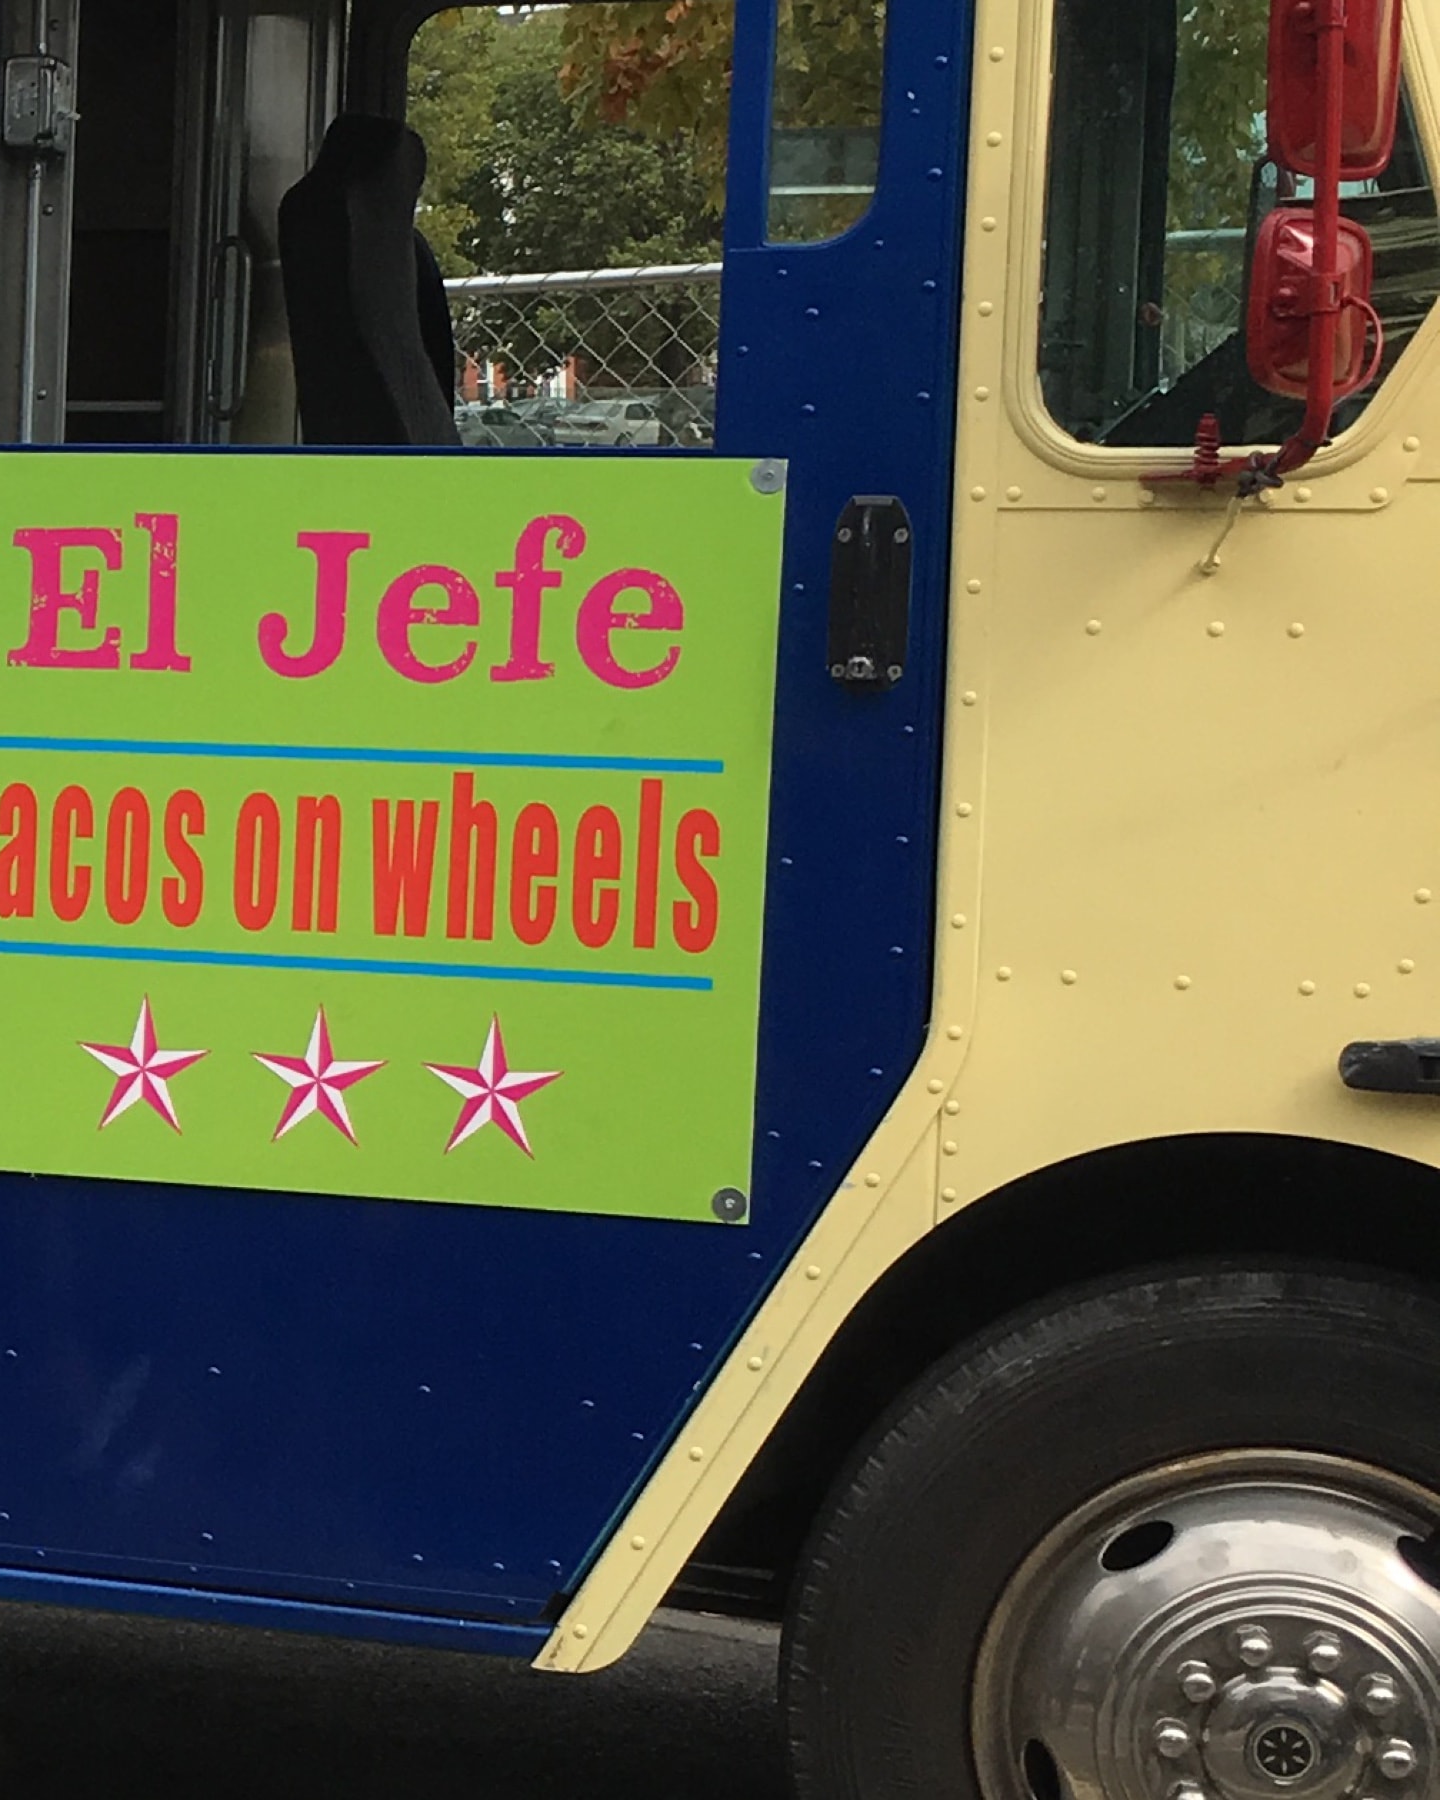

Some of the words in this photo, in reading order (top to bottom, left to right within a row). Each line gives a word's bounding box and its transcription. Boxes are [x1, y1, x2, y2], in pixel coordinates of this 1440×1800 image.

[7, 513, 191, 672] El
[258, 515, 684, 688] Jefe
[234, 792, 342, 932] on
[371, 772, 720, 952] wheels
